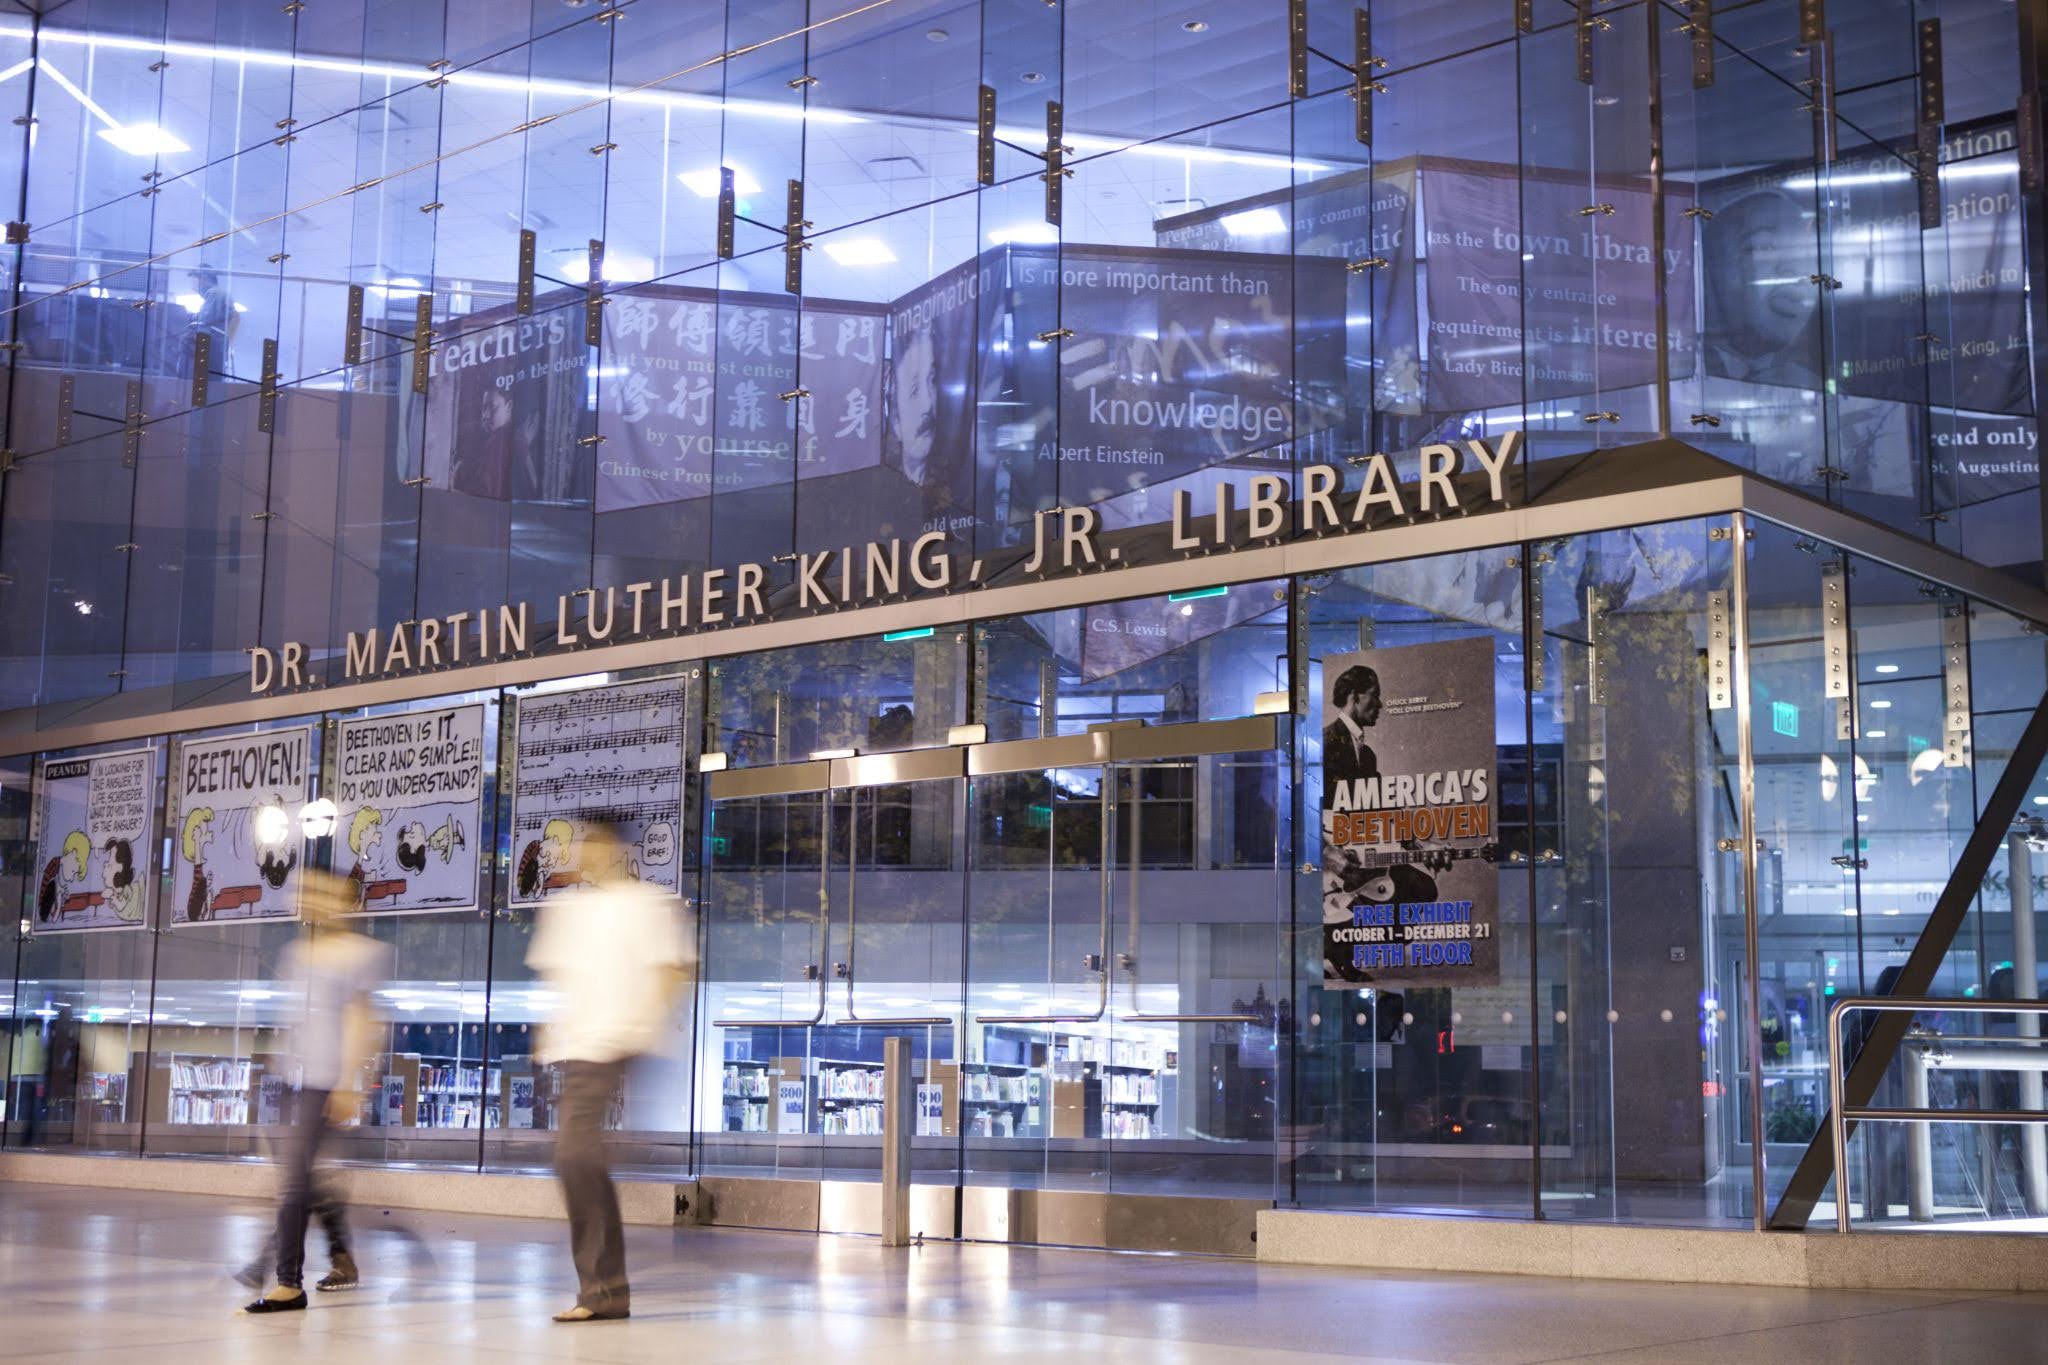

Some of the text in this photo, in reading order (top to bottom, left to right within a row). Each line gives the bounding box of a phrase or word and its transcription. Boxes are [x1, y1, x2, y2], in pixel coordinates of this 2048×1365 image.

[1455, 231, 1484, 249] the
[1491, 226, 1571, 256] town
[1581, 231, 1692, 274] libray.
[1105, 266, 1213, 294] important
[1220, 271, 1270, 296] than
[1456, 275, 1490, 296] The
[1496, 281, 1536, 301] ony
[2000, 268, 2018, 283] to
[1430, 318, 1542, 343] requirement
[1960, 338, 2000, 358] King,
[643, 354, 681, 379] you
[743, 360, 794, 380] enter
[1445, 358, 1487, 378] Lady
[1528, 362, 1594, 383] Johnson
[1088, 386, 1293, 440] knowledge.
[646, 426, 827, 463] by yoursef.
[1986, 426, 2039, 451] only
[1096, 445, 1165, 466] Einstein
[600, 461, 744, 485] Chinese Proverb
[250, 431, 1523, 694] DR. MARTIN LUTHER KING, JR. LIBRARY
[1091, 617, 1168, 637] C.S. Lewis
[346, 712, 458, 752] BEETHOVEN IS IT,
[47, 761, 89, 778] PEANUTS
[186, 738, 302, 796] BEETHOVEN!
[345, 738, 480, 776] CLEAR AND SIMPLE!!
[92, 778, 104, 792] THE
[341, 764, 479, 801] DO YOU UNDERSTAND?
[1332, 768, 1489, 812] AMERICA'S
[647, 832, 668, 844] GOOD
[1332, 803, 1490, 847] BEETHOVEN
[1352, 900, 1473, 928] FREE EXHIBIT
[1332, 928, 1386, 943] OCTOBER
[1475, 922, 1491, 939] 21
[1352, 942, 1473, 970] FIFTH FLOOR
[512, 1082, 533, 1096] 500
[780, 1086, 803, 1099] 800
